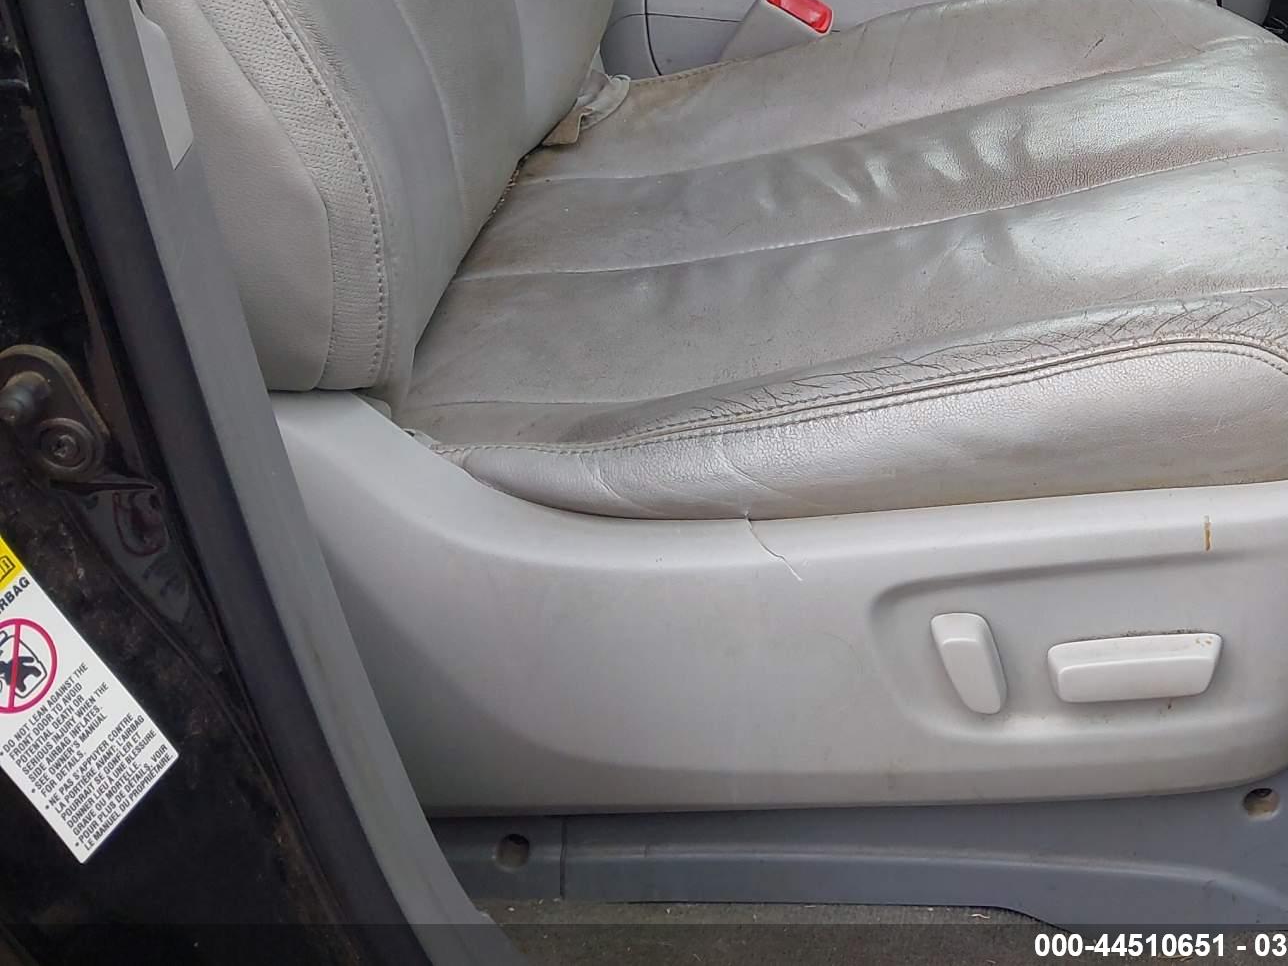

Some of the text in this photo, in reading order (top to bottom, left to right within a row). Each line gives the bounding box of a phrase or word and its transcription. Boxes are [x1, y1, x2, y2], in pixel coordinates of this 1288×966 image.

[0, 576, 30, 614] RBAG
[2, 661, 88, 753] DO NOT LEAN AGAINST THE
[8, 681, 82, 761] FRONT DOOR TO AVOID
[15, 693, 84, 769] POTENTIAL DEATH OR
[21, 681, 108, 776] SERIOUS INJURY WHEN THE
[28, 762, 46, 783] SIDE
[44, 735, 71, 766] AIRBAG
[34, 710, 107, 790] SEE OWNER'S MANUAL
[40, 778, 57, 798] FOR
[48, 712, 133, 806] NE PAS S'APPUYER CONTRE
[54, 800, 66, 814] LA
[115, 713, 144, 747] L'AIRBAG
[60, 731, 141, 822] POURRAIT SE GONFLER ET
[66, 796, 95, 829] DONNER
[92, 780, 109, 800] LIEU
[111, 761, 127, 778] UNE
[124, 728, 156, 764] BLESSURE
[72, 808, 97, 836] GRAVE
[94, 797, 107, 812] OU
[77, 819, 99, 844] POUR
[96, 800, 116, 823] PLUS
[114, 790, 126, 803] DE
[150, 743, 167, 763] VOIR
[84, 837, 95, 850] LE
[92, 809, 120, 841] MANUEL
[118, 798, 130, 812] DU
